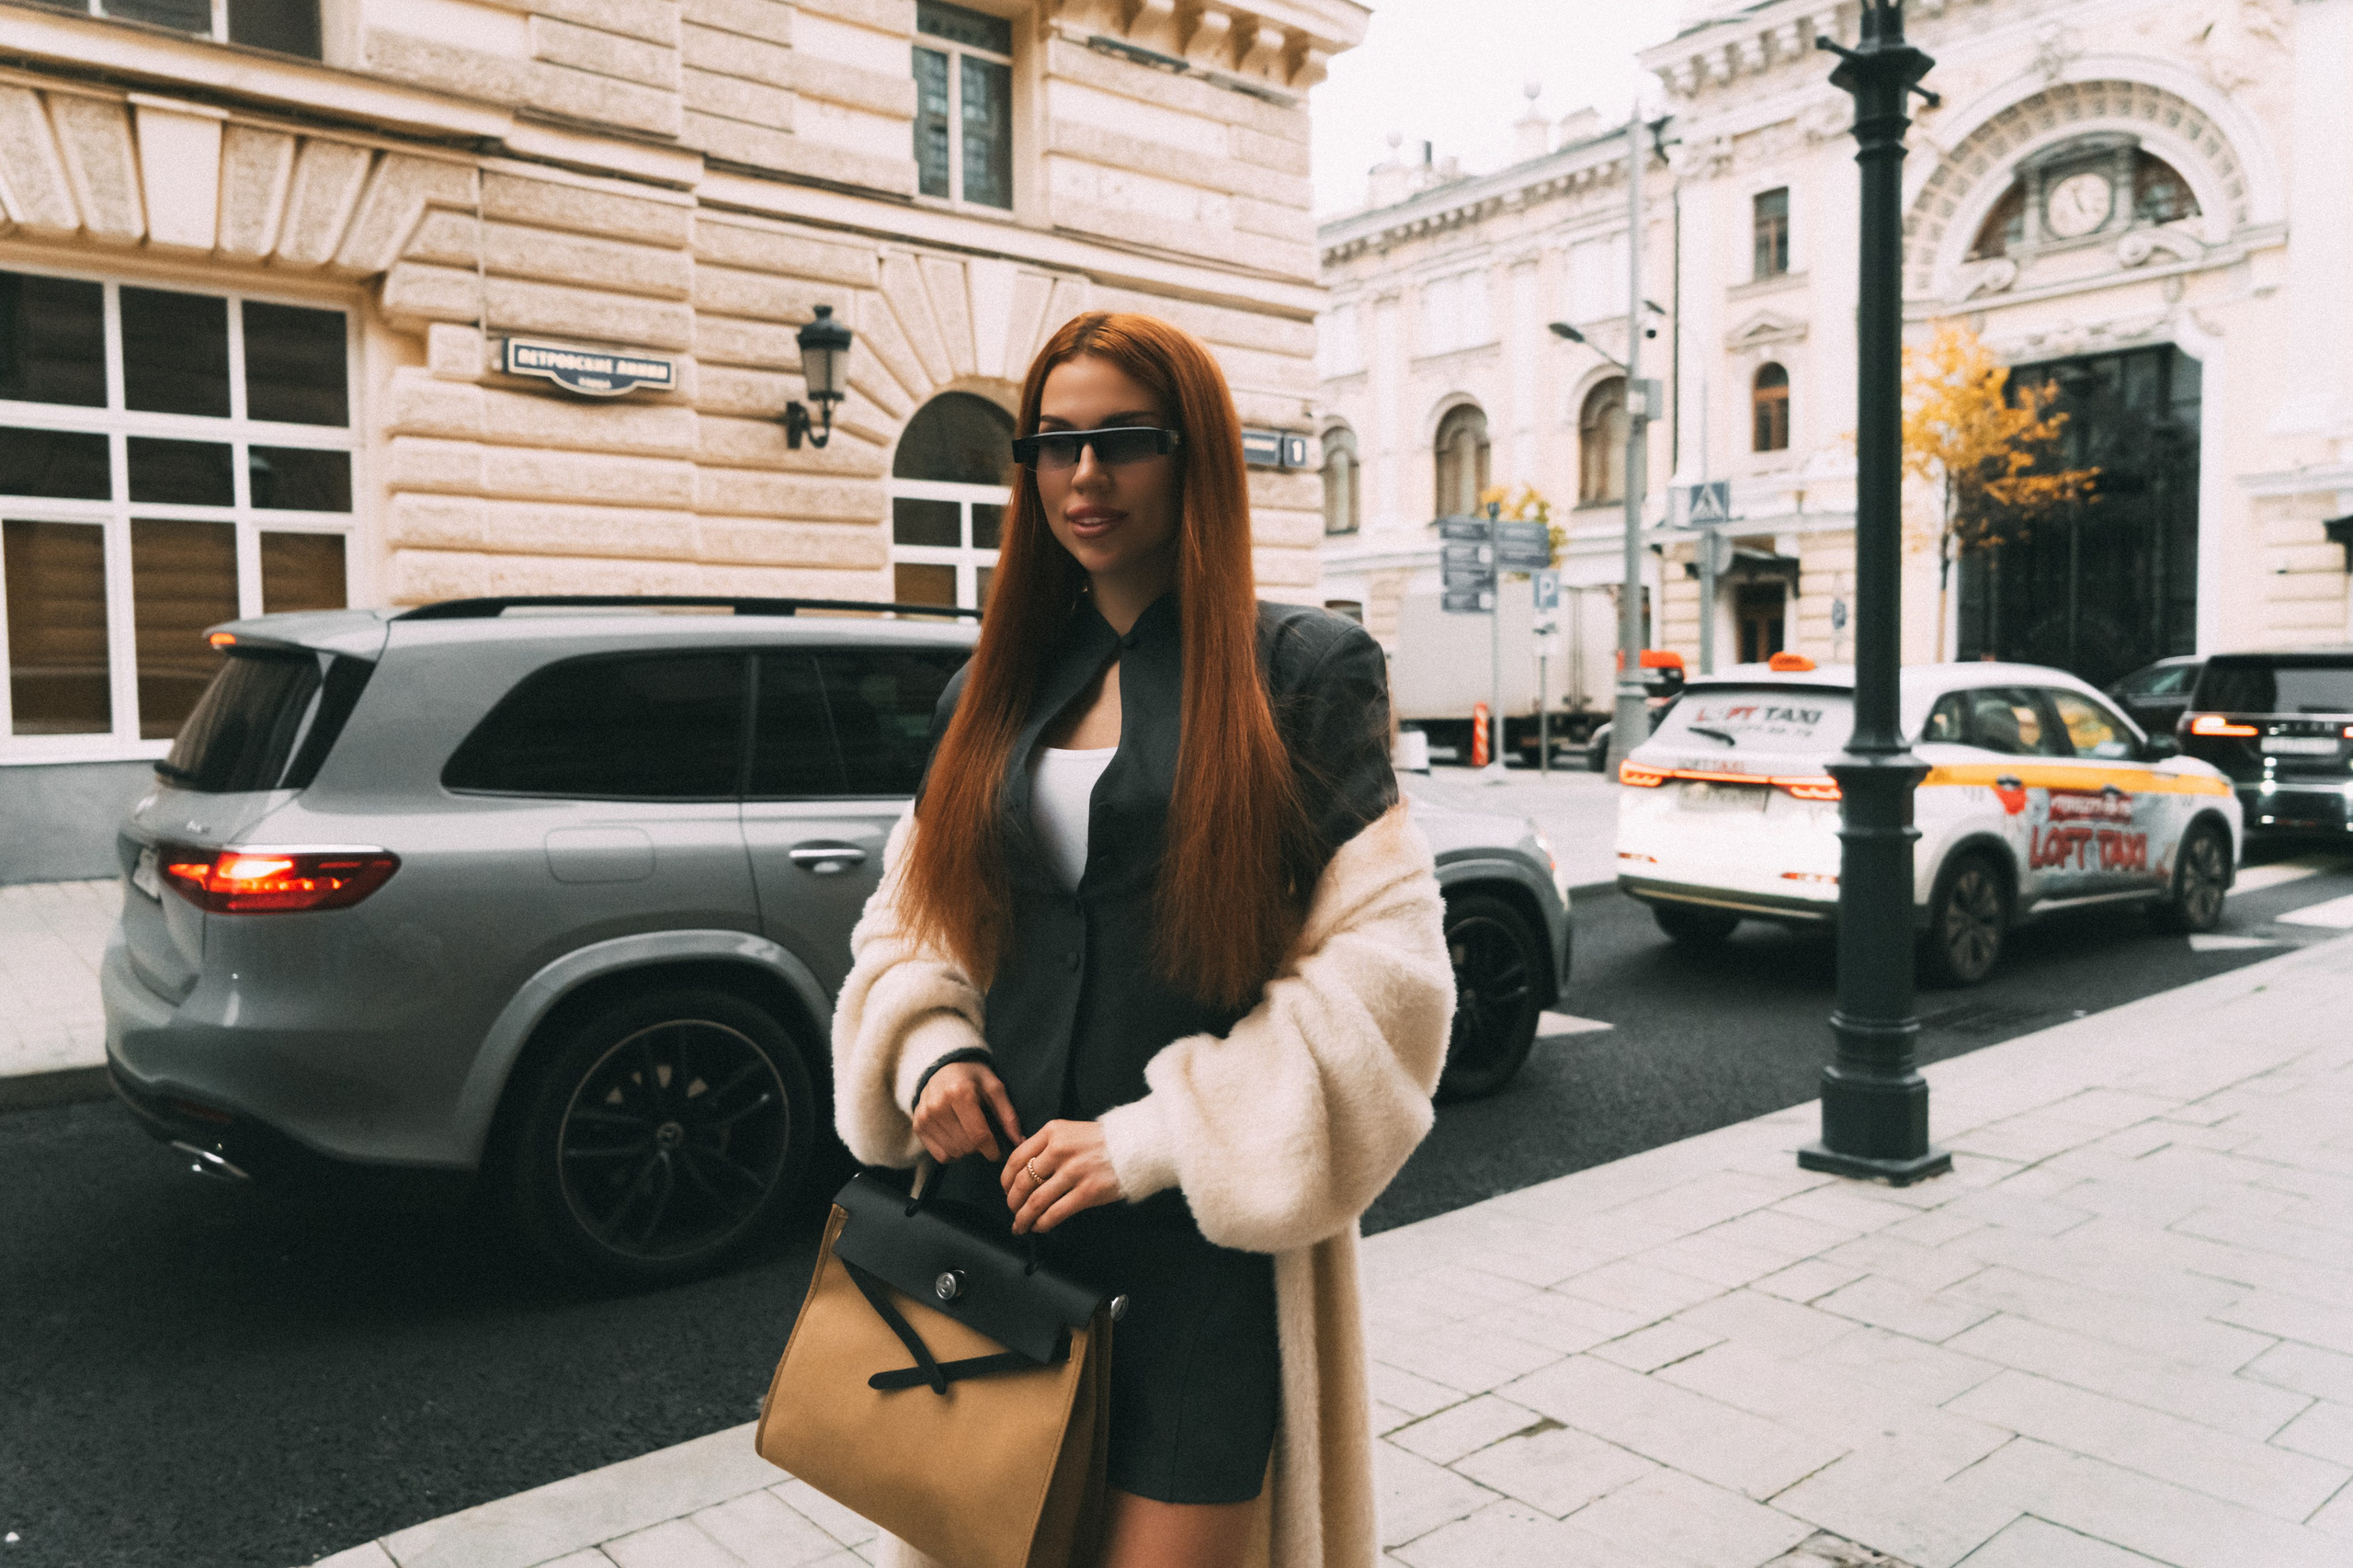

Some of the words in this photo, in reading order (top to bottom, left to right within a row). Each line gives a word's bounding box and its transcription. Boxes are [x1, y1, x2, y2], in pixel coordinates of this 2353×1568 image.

[1764, 706, 1824, 725] TAXI
[2028, 824, 2094, 870] LOFT
[2096, 828, 2148, 871] TAXI
